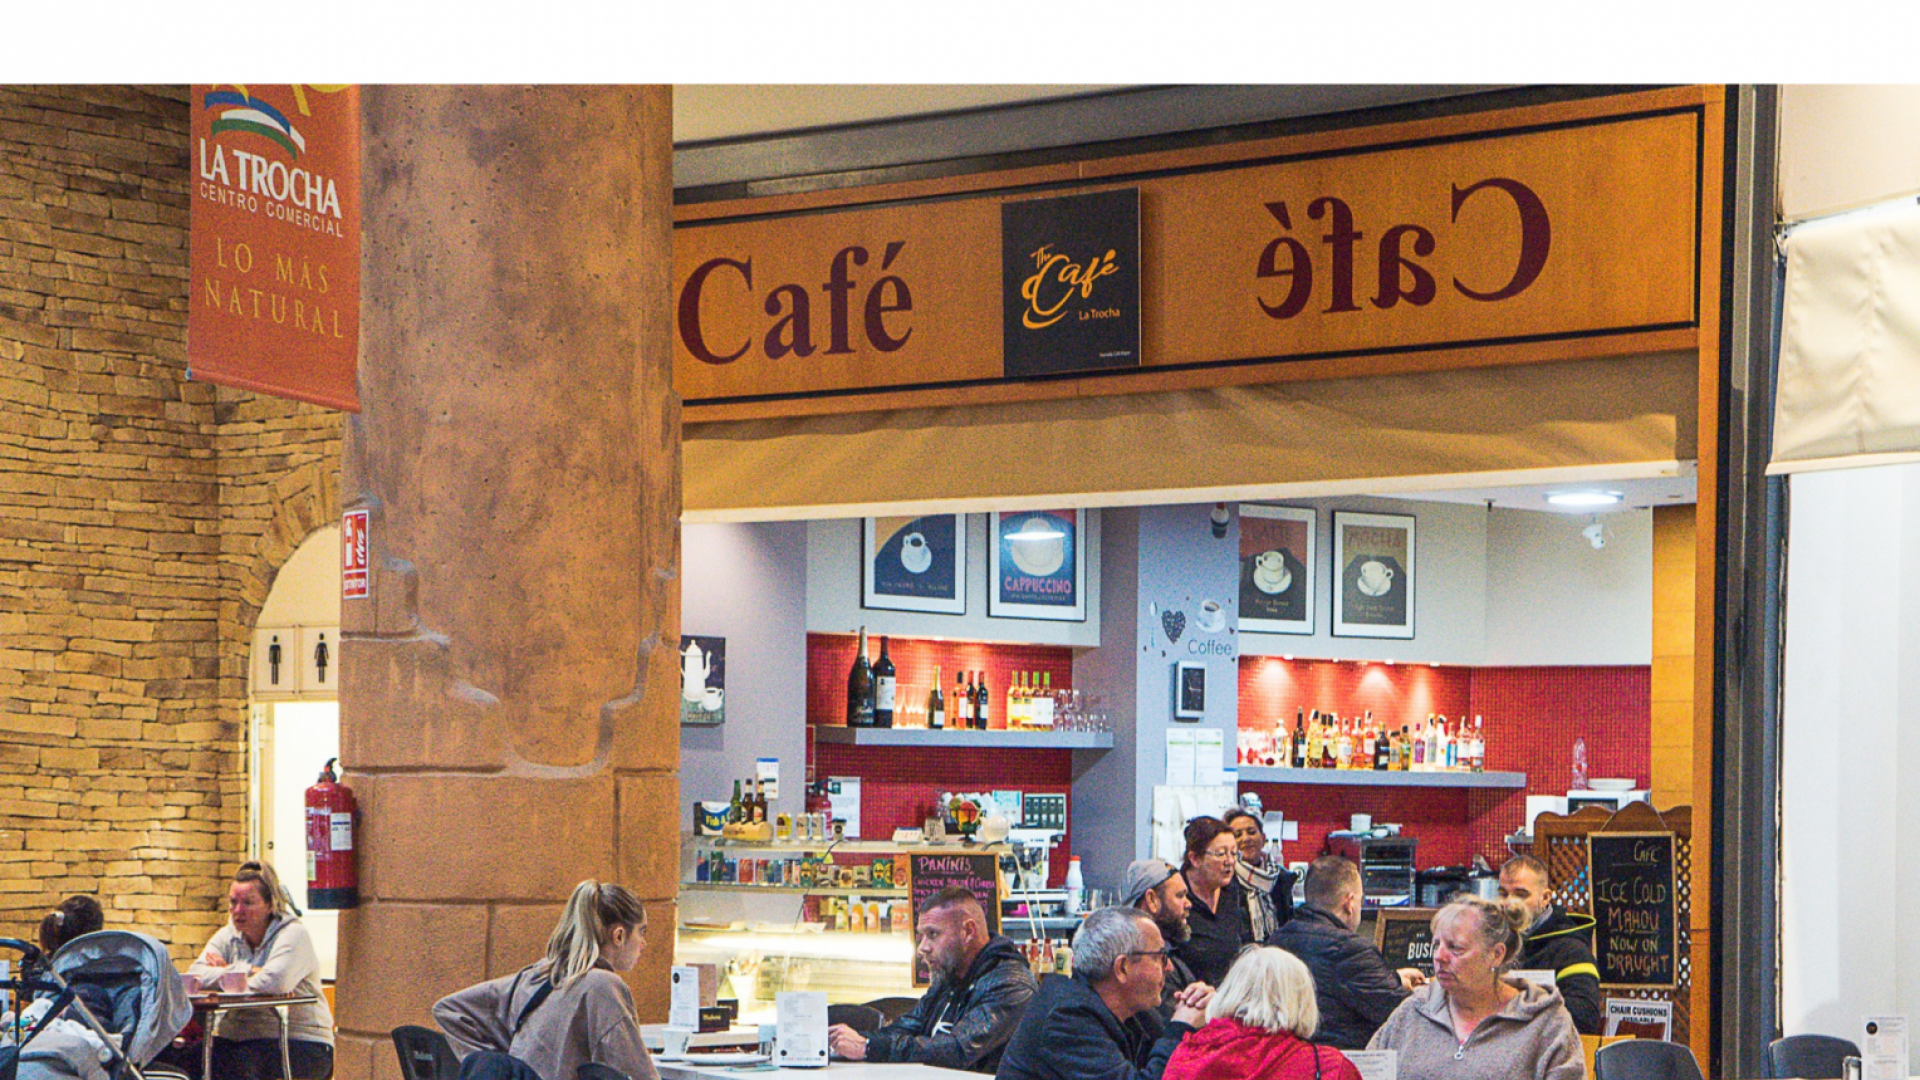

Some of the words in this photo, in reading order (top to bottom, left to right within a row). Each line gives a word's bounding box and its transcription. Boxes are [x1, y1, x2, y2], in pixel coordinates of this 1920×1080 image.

[200, 137, 230, 186] LA
[233, 149, 343, 219] TROCHA
[200, 182, 258, 213] CENTRO
[265, 201, 344, 238] COMERCIAL
[216, 237, 253, 274] LO
[275, 253, 329, 294] MÁS
[1021, 248, 1120, 318] Café
[204, 277, 344, 338] NATURAL
[677, 241, 913, 366] Café
[1078, 310, 1090, 321] La
[1091, 307, 1121, 320] Trocha
[1004, 575, 1073, 595] CAPPUCCINO
[1188, 639, 1233, 656] Coffee
[1598, 878, 1628, 903] ICE
[1632, 875, 1667, 905] COLD
[1607, 906, 1660, 931] MAHOU
[1609, 934, 1638, 953] NOW
[1641, 934, 1660, 953] ON
[1606, 952, 1670, 977] DRAUGHT
[1610, 1005, 1632, 1014] CHAIR
[1632, 1006, 1668, 1018] CUSHIONS
